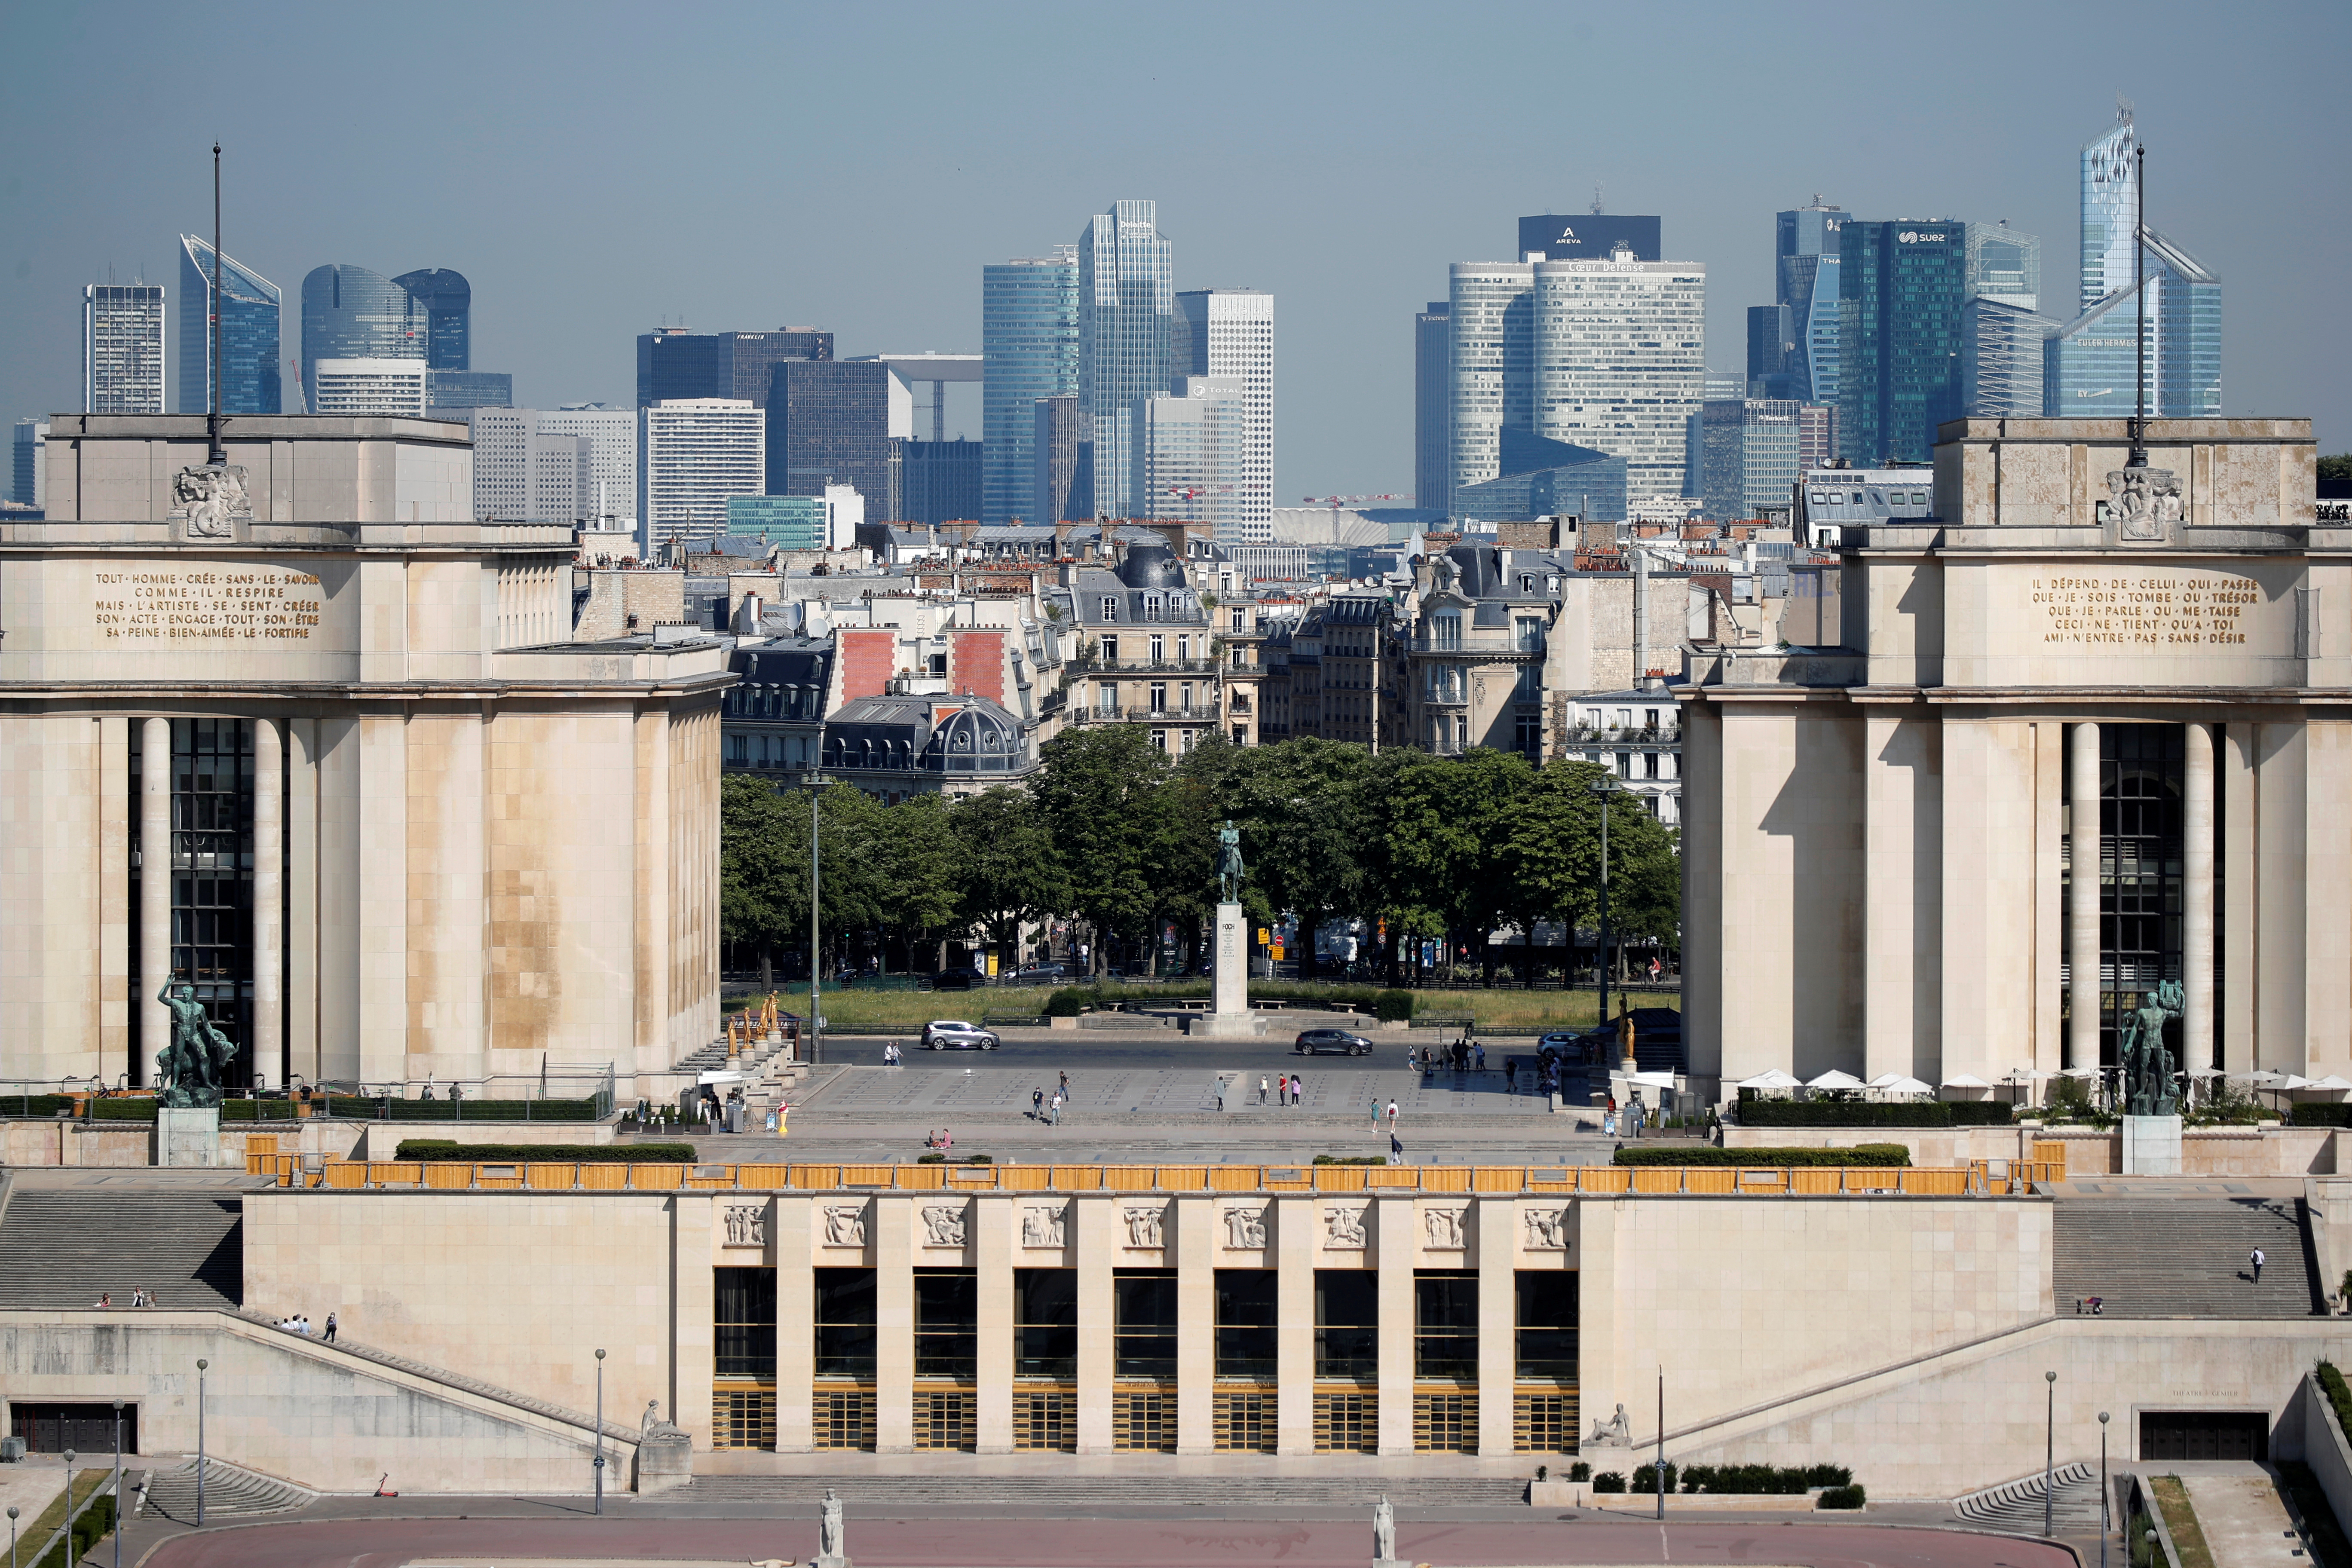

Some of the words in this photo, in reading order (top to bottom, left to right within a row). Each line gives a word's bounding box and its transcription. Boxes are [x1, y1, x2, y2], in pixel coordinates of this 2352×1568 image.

[1569, 263, 1596, 272] Cœur
[1210, 303, 1272, 315] ariane
[2104, 339, 2136, 347] HERMES
[96, 574, 123, 584] TOUT
[132, 574, 176, 584] HOMME
[186, 573, 216, 584] CRÉE
[226, 574, 254, 585] SANS
[263, 574, 276, 585] LE
[284, 574, 319, 585] SAVOIR
[2033, 579, 2042, 589] IL
[2051, 577, 2099, 590] DÉPEND
[2111, 579, 2127, 589] DE
[2139, 579, 2176, 589] CELUI
[2187, 579, 2211, 590] QUI
[2221, 579, 2257, 591] PASSE
[135, 588, 187, 597] COMME
[201, 588, 214, 597] IL
[226, 588, 284, 598] RESPIRE
[2033, 592, 2054, 604] QUE
[2064, 592, 2076, 603] JE
[2088, 592, 2116, 603] SOIS
[2128, 592, 2171, 603] TOMBE
[2183, 592, 2201, 603] OU
[2211, 591, 2258, 604] TRÉSOR
[95, 600, 124, 610] MAIS
[212, 601, 228, 611] SE
[241, 601, 272, 611] SENT
[283, 599, 320, 612] CRÉER
[2049, 606, 2071, 617] QUE
[2082, 606, 2094, 616] JE
[2105, 606, 2142, 616] PARLE
[2153, 606, 2171, 616] OU
[2183, 606, 2200, 617] ME
[2208, 606, 2241, 617] TAISE
[96, 614, 119, 624] SON
[129, 614, 158, 624] ACTE
[169, 614, 216, 624] ENGAGE
[224, 614, 255, 625] TOUT
[263, 614, 287, 625] SON
[295, 612, 319, 626] ÊTRE
[2055, 619, 2083, 630] CECI
[2095, 619, 2110, 630] NE
[2122, 619, 2159, 630] TIENT
[2212, 619, 2234, 631] TOI
[107, 627, 119, 638] SA
[128, 627, 159, 637] PEINE
[169, 626, 235, 638] BIEN-AIMÉE
[244, 628, 256, 638] LE
[264, 628, 309, 639] FORTIFIE
[2043, 633, 2063, 643] AMI
[2135, 633, 2157, 643] PAS
[2168, 633, 2200, 643] SANS
[2209, 631, 2246, 644] DÉSIR
